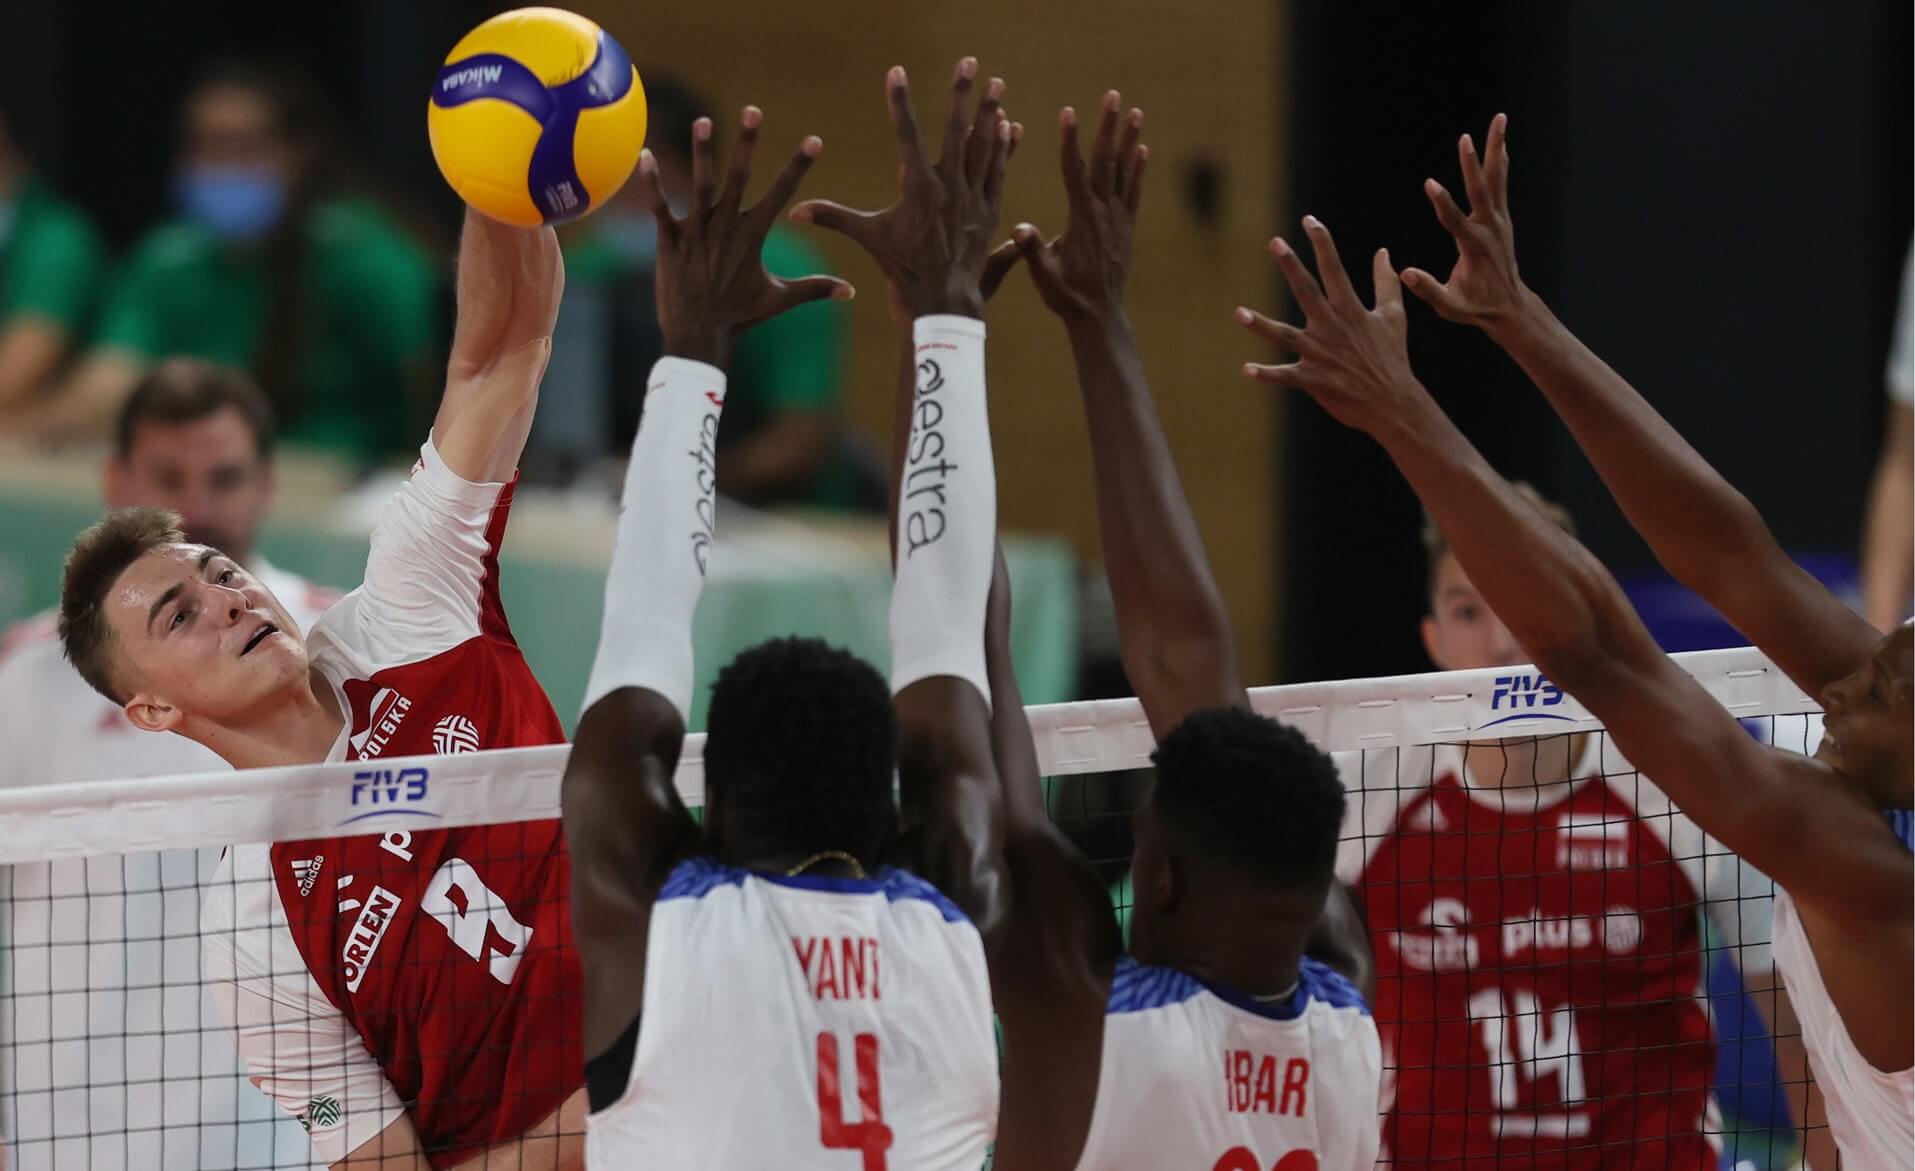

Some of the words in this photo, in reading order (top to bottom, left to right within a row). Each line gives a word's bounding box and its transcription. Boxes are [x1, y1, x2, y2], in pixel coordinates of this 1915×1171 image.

[351, 767, 429, 806] FIVB
[300, 855, 324, 897] adidas
[343, 893, 395, 983] ORLEN
[1502, 907, 1592, 957] plus
[1468, 987, 1587, 1109] 14
[816, 1031, 894, 1171] 4
